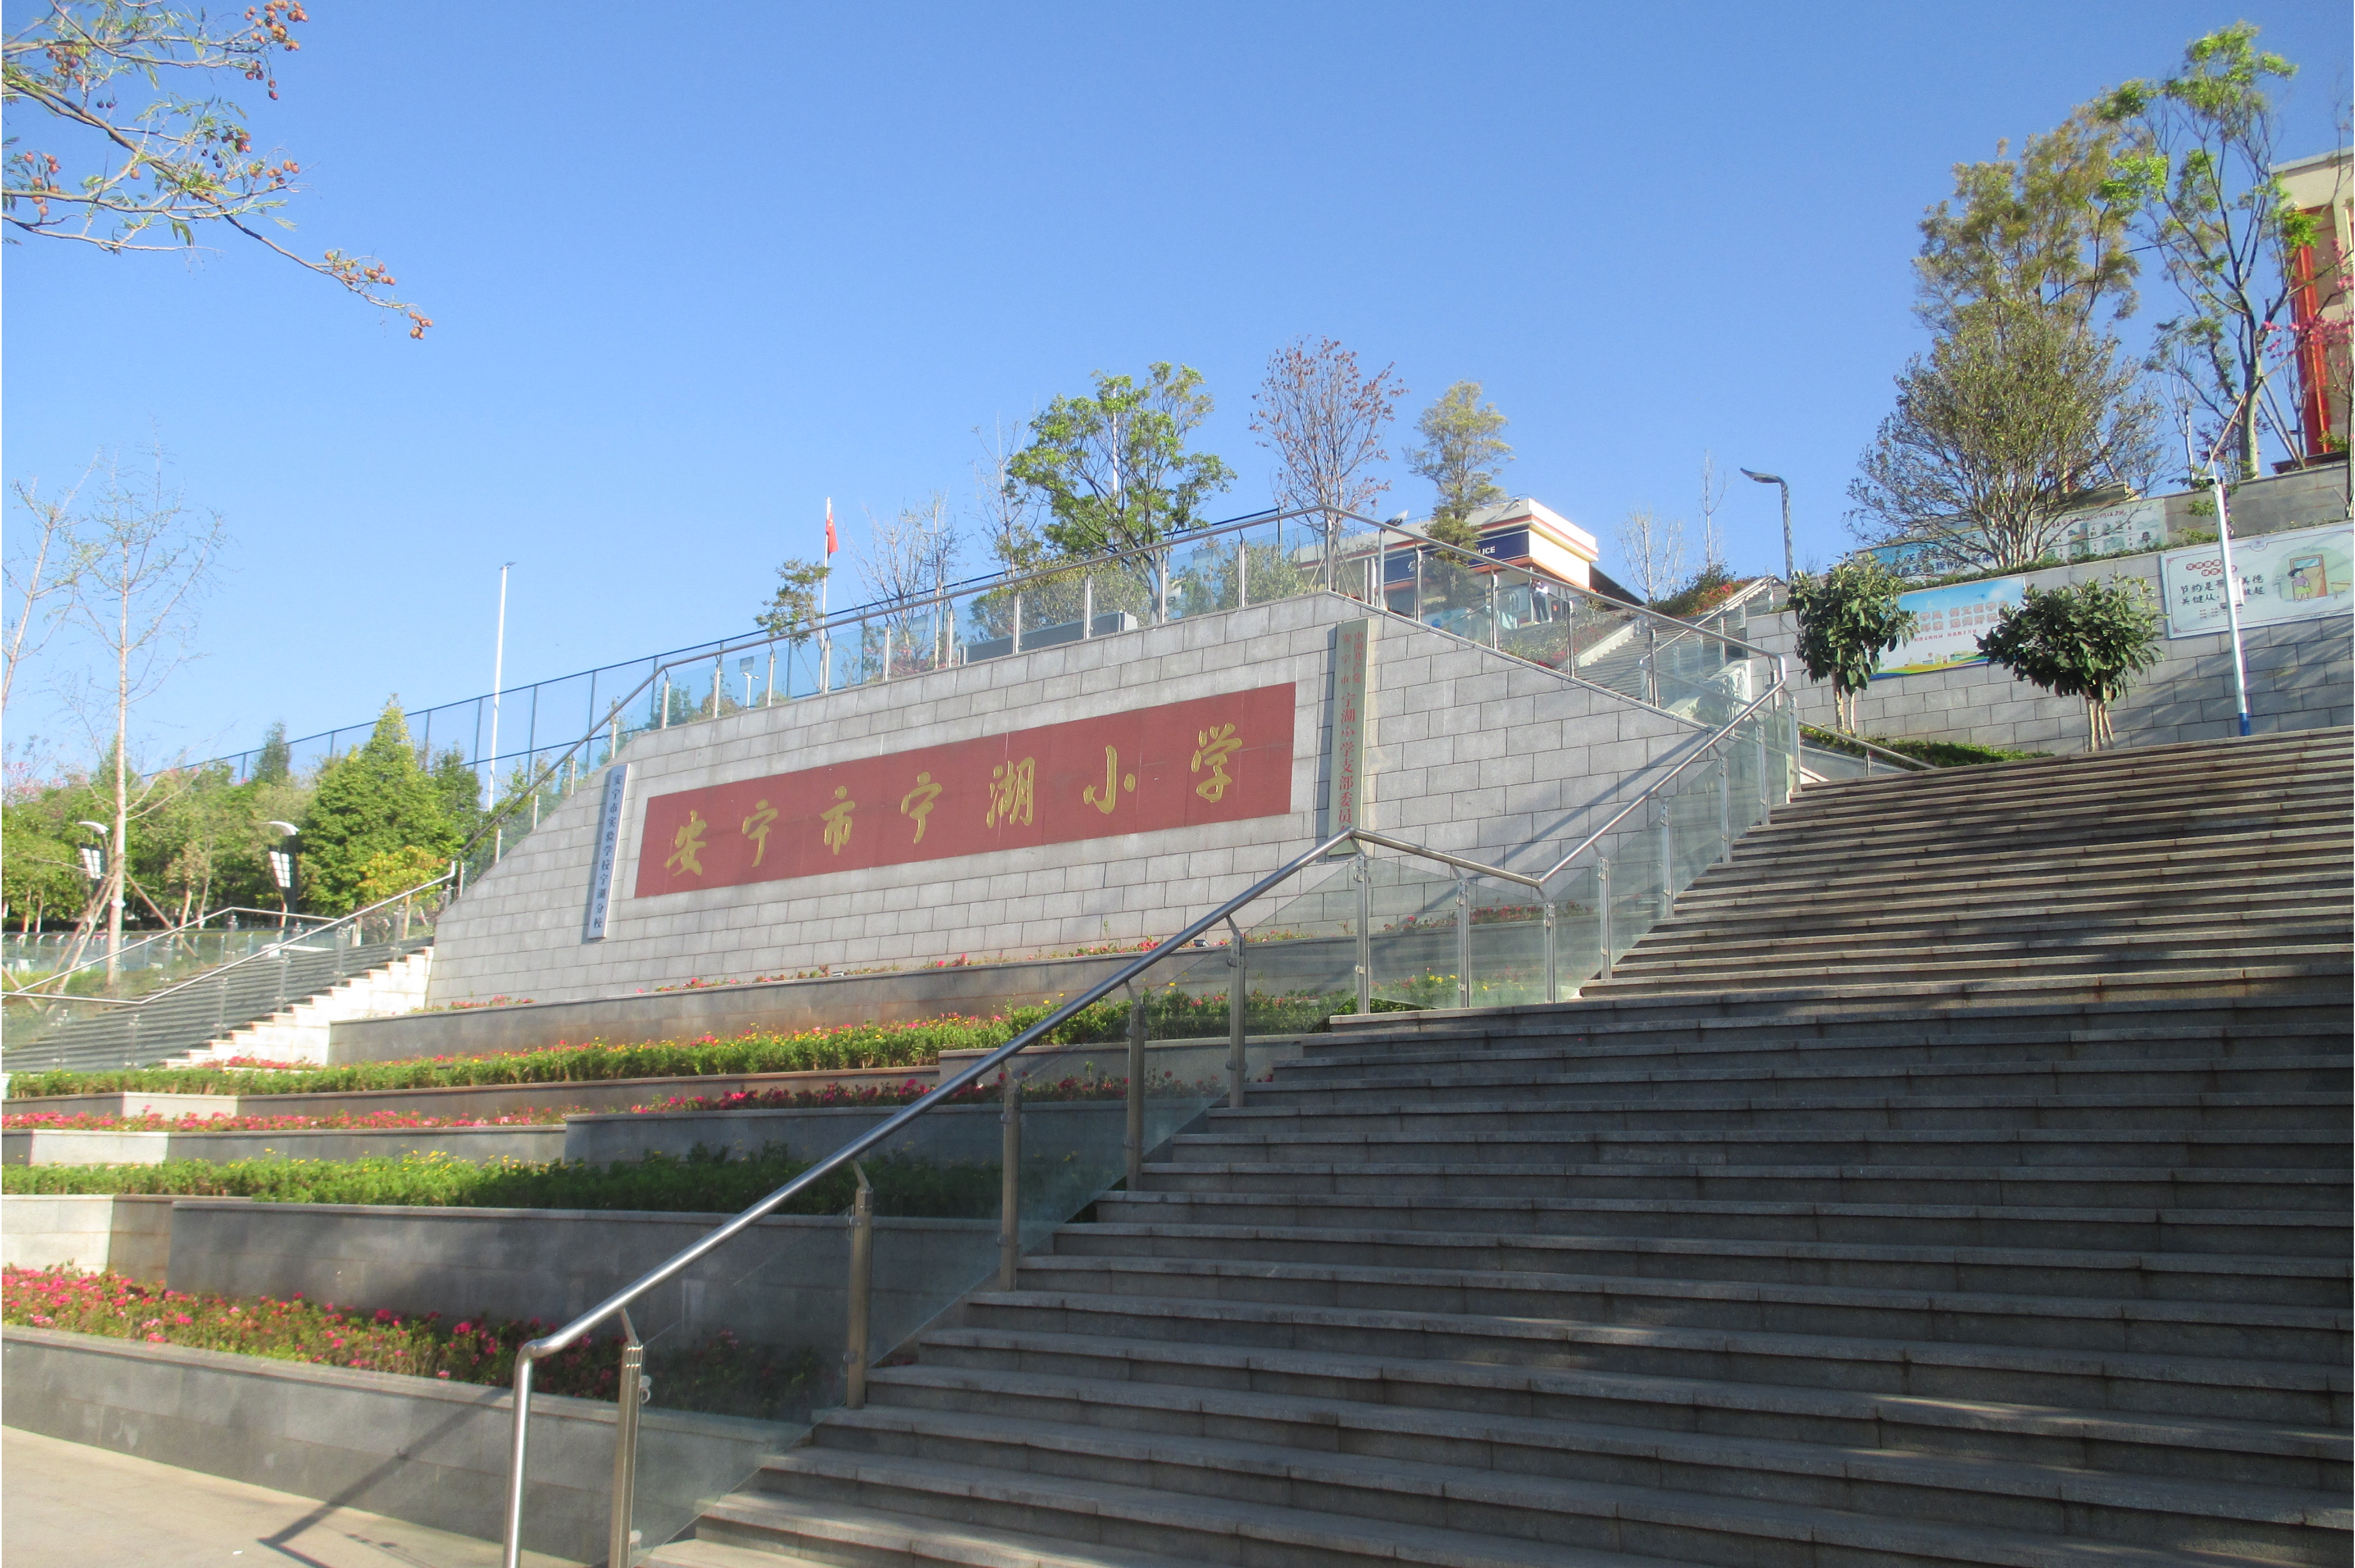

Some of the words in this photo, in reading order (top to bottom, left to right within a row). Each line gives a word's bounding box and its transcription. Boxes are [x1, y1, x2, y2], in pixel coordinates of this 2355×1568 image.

[1341, 633, 1352, 684] 安宁市
[1352, 631, 1364, 683] 中国共产党
[663, 722, 1243, 877] 安宁市宁湖小学
[593, 774, 622, 929] 安宁市实验学校宁湖分校
